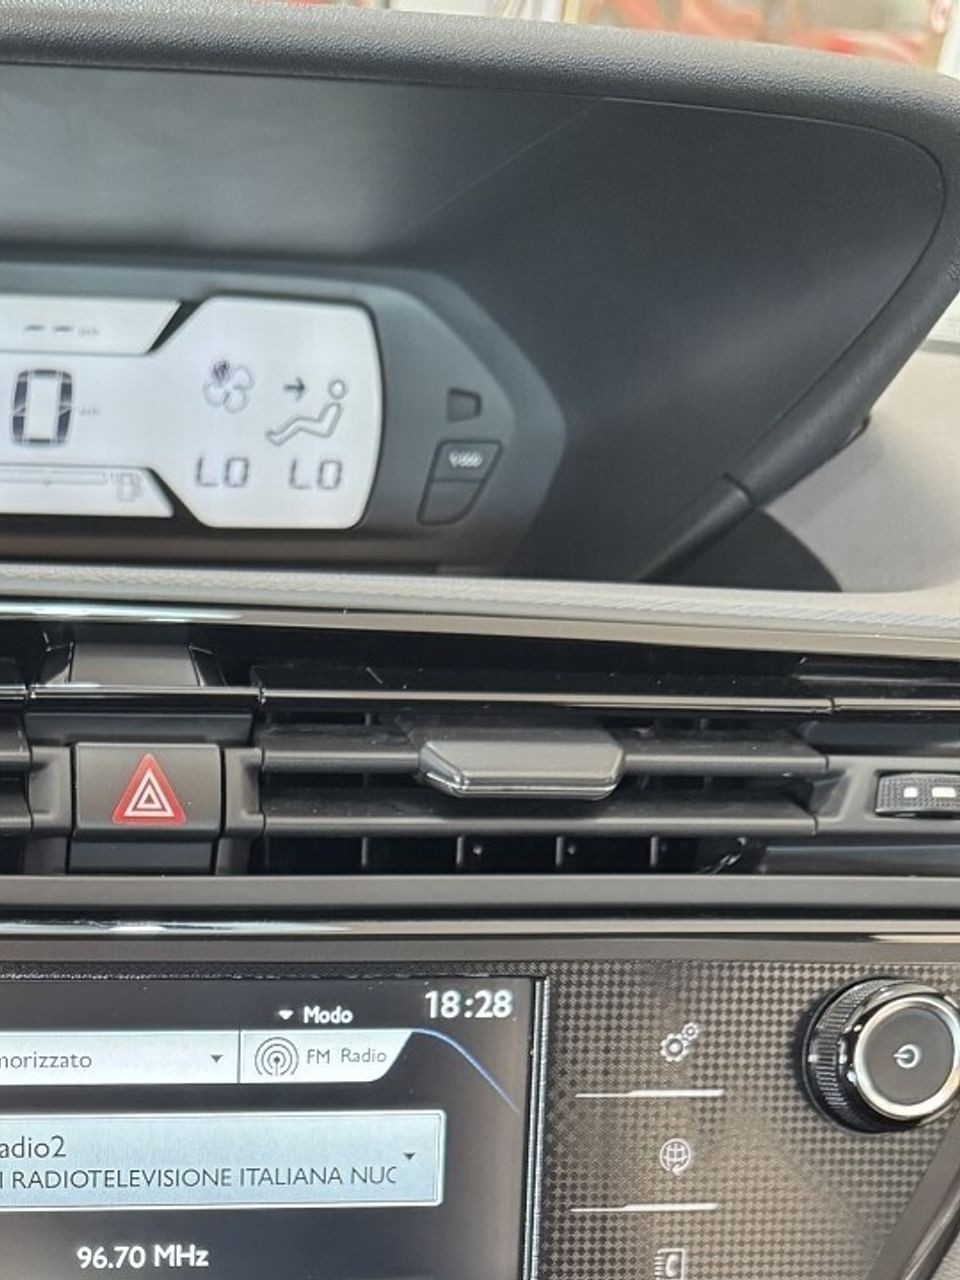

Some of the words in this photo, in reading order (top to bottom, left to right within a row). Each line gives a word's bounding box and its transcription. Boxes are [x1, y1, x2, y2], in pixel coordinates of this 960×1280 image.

[12, 368, 73, 447] 0
[196, 456, 250, 489] LO
[289, 459, 343, 491] LO
[303, 1006, 353, 1024] Modo
[424, 990, 513, 1020] 18:28
[306, 1050, 330, 1064] FM
[341, 1047, 387, 1063] Radio
[12, 1167, 231, 1189] RADIOTELEVISIONE
[240, 1166, 343, 1187] ITALIANA
[76, 1246, 146, 1269] 96.70
[154, 1244, 209, 1267] MHz
